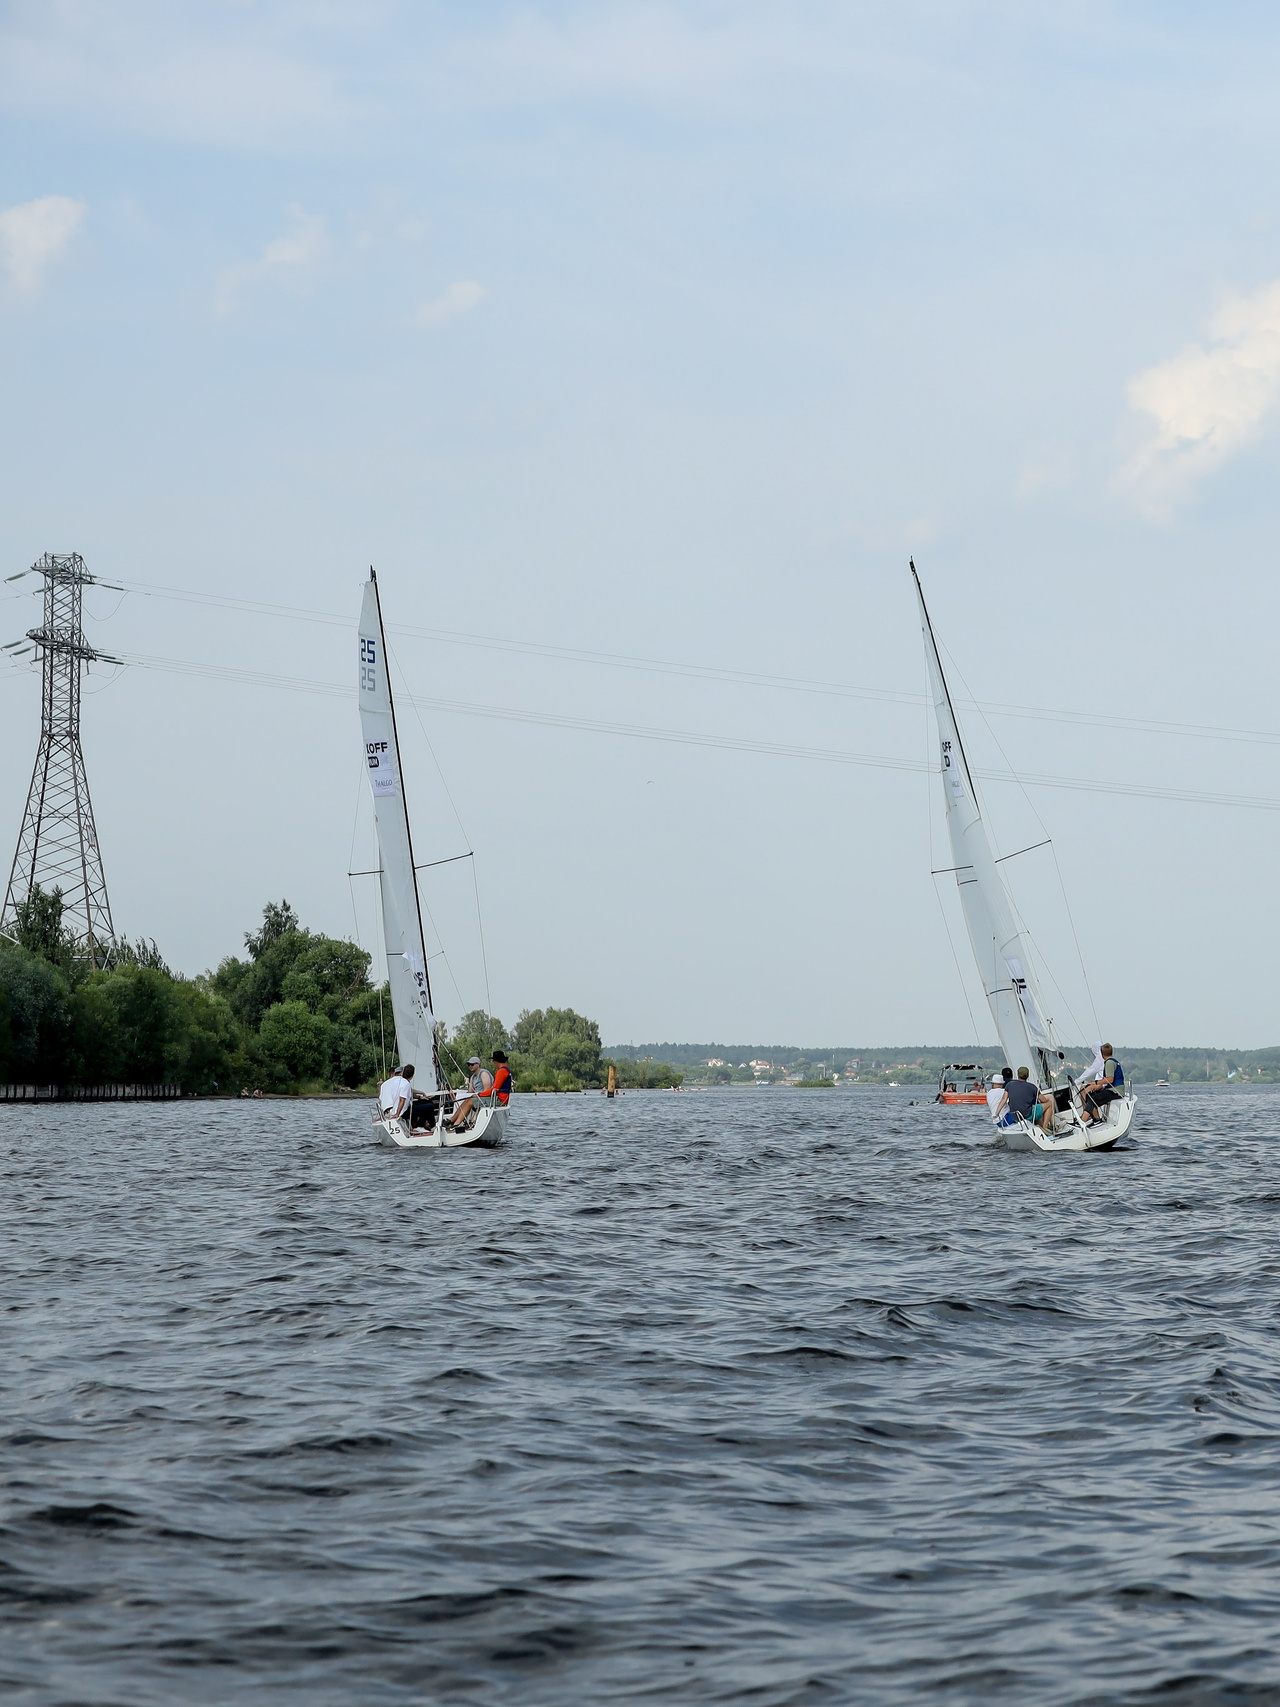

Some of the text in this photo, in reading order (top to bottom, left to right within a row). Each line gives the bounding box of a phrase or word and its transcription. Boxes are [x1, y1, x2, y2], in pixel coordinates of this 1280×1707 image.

[360, 638, 376, 664] 25
[361, 666, 376, 692] 25
[389, 1126, 401, 1135] 25
